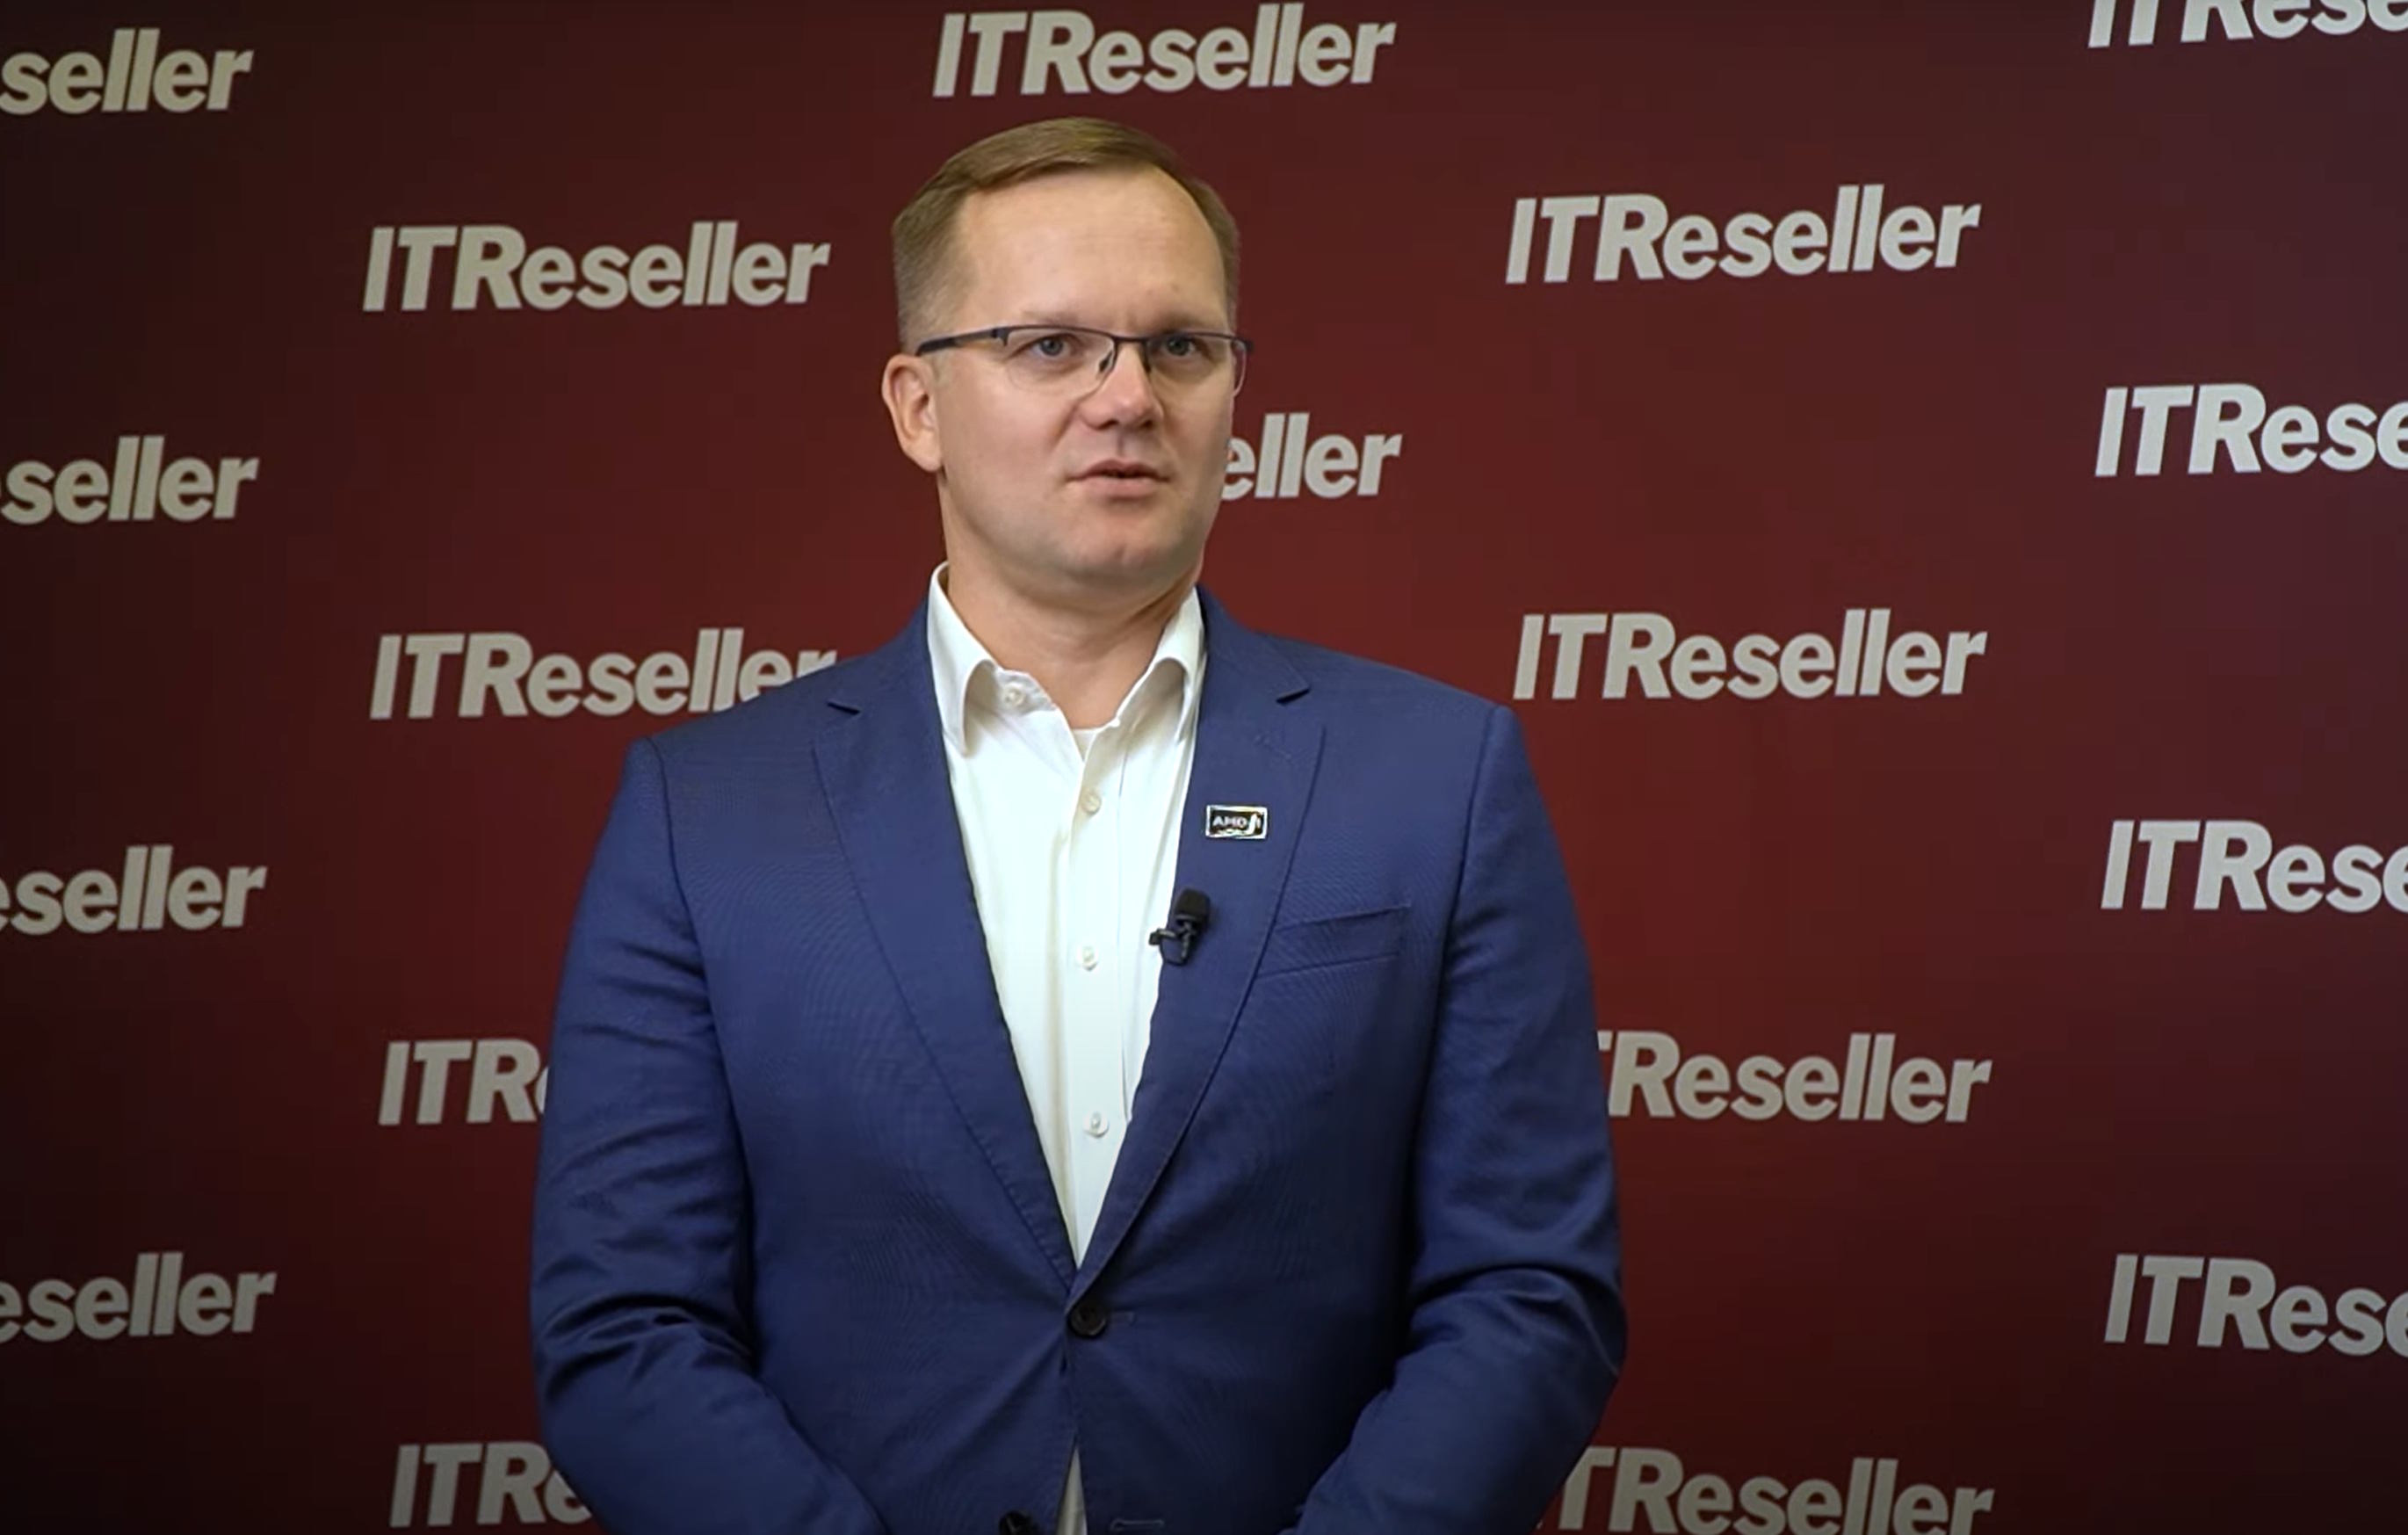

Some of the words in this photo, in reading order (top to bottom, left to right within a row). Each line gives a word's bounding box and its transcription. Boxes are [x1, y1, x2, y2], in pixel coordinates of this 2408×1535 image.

[932, 2, 1397, 98] ITReseller
[2087, 0, 2408, 48] Ies
[0, 28, 253, 114] seller
[363, 221, 831, 312] ITReseller
[1505, 184, 1982, 285] ITReseller
[0, 435, 260, 525] seller
[1513, 608, 1988, 700] ITReseller
[0, 844, 268, 935] seller
[378, 1039, 549, 1126] ITR
[1597, 1031, 1993, 1123] Reseller
